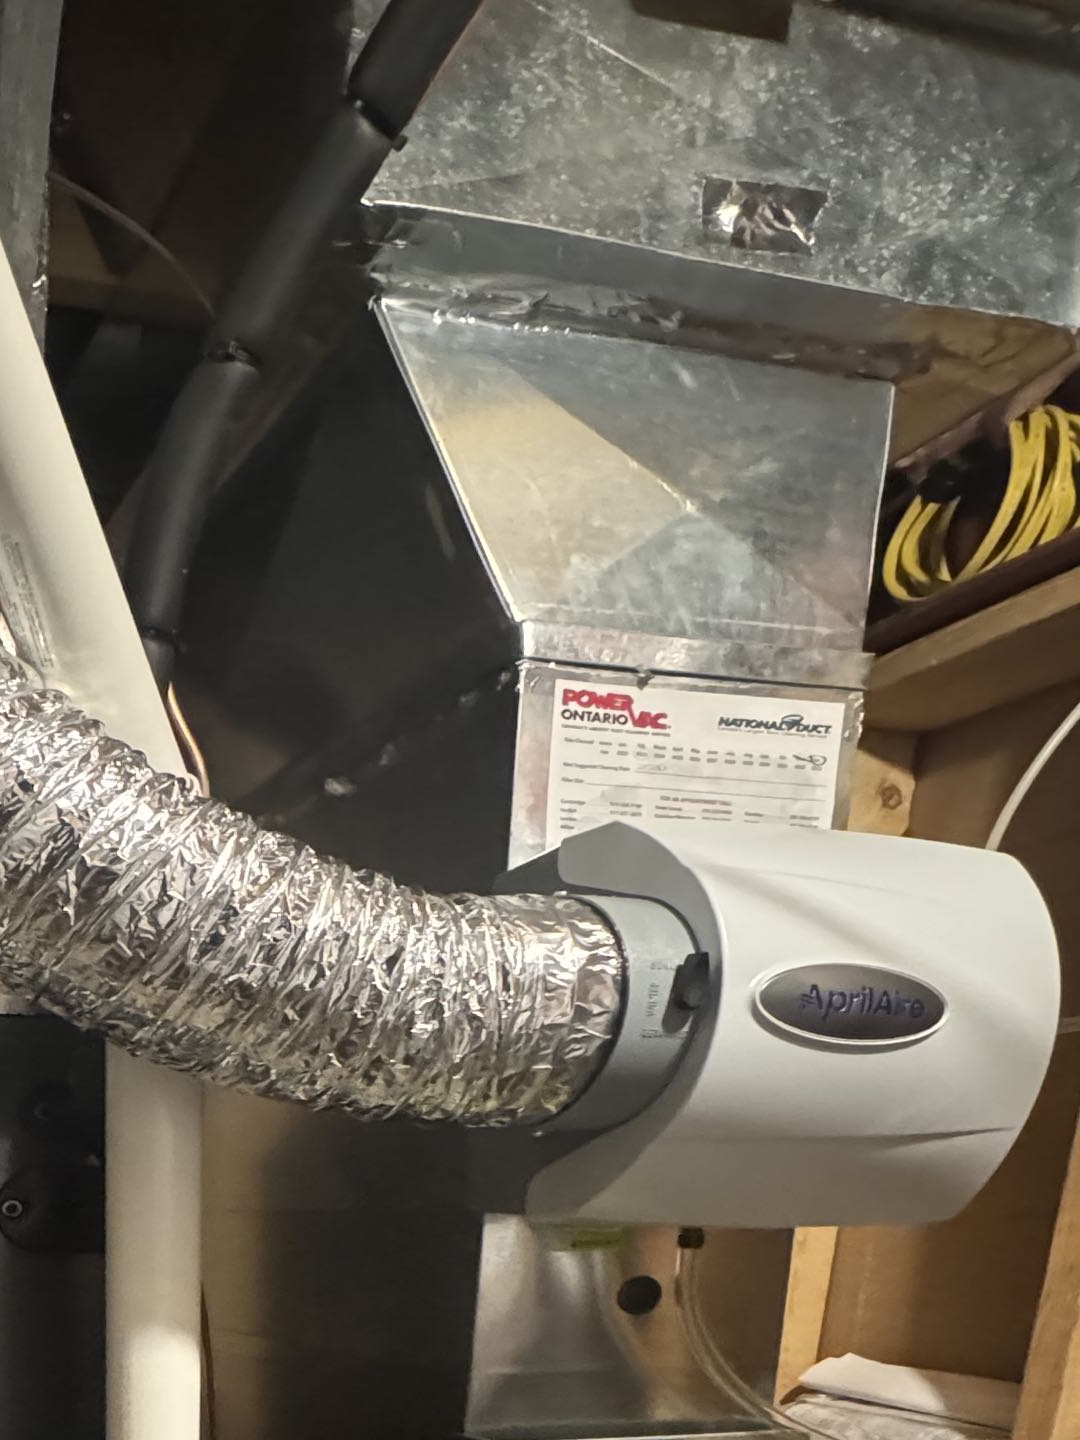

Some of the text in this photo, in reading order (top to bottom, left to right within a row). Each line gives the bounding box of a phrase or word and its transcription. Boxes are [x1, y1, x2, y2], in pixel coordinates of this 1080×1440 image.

[561, 709, 629, 725] ONTARIO
[718, 716, 784, 731] NATIONAL
[796, 724, 833, 735] DUCT
[801, 984, 925, 1021] AprilAire
